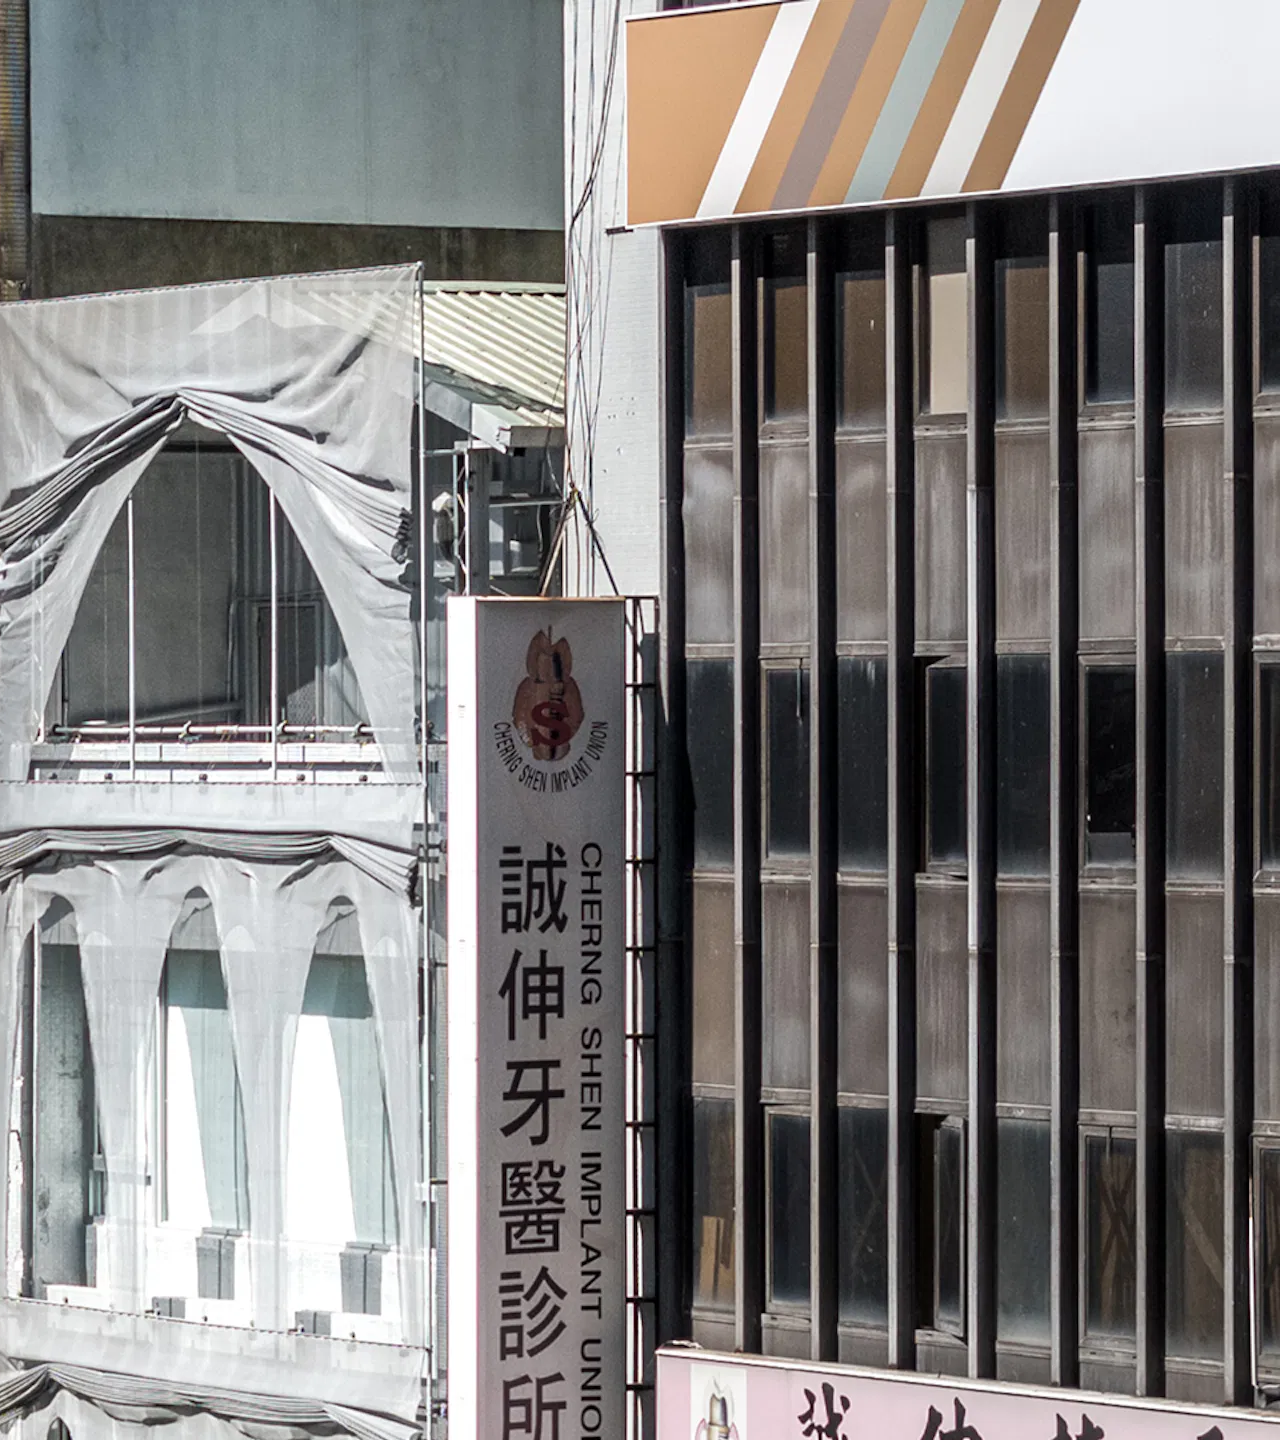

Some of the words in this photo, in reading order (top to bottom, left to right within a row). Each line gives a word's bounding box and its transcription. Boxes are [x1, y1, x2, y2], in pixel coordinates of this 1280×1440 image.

[492, 720, 518, 774] CHERNG
[518, 763, 548, 793] SHEN
[551, 757, 592, 794] IMPLANT
[585, 720, 609, 763] UNION
[580, 842, 603, 1005] CHERNG
[580, 1027, 603, 1131] SHEN
[580, 1152, 603, 1319] IMPLANT
